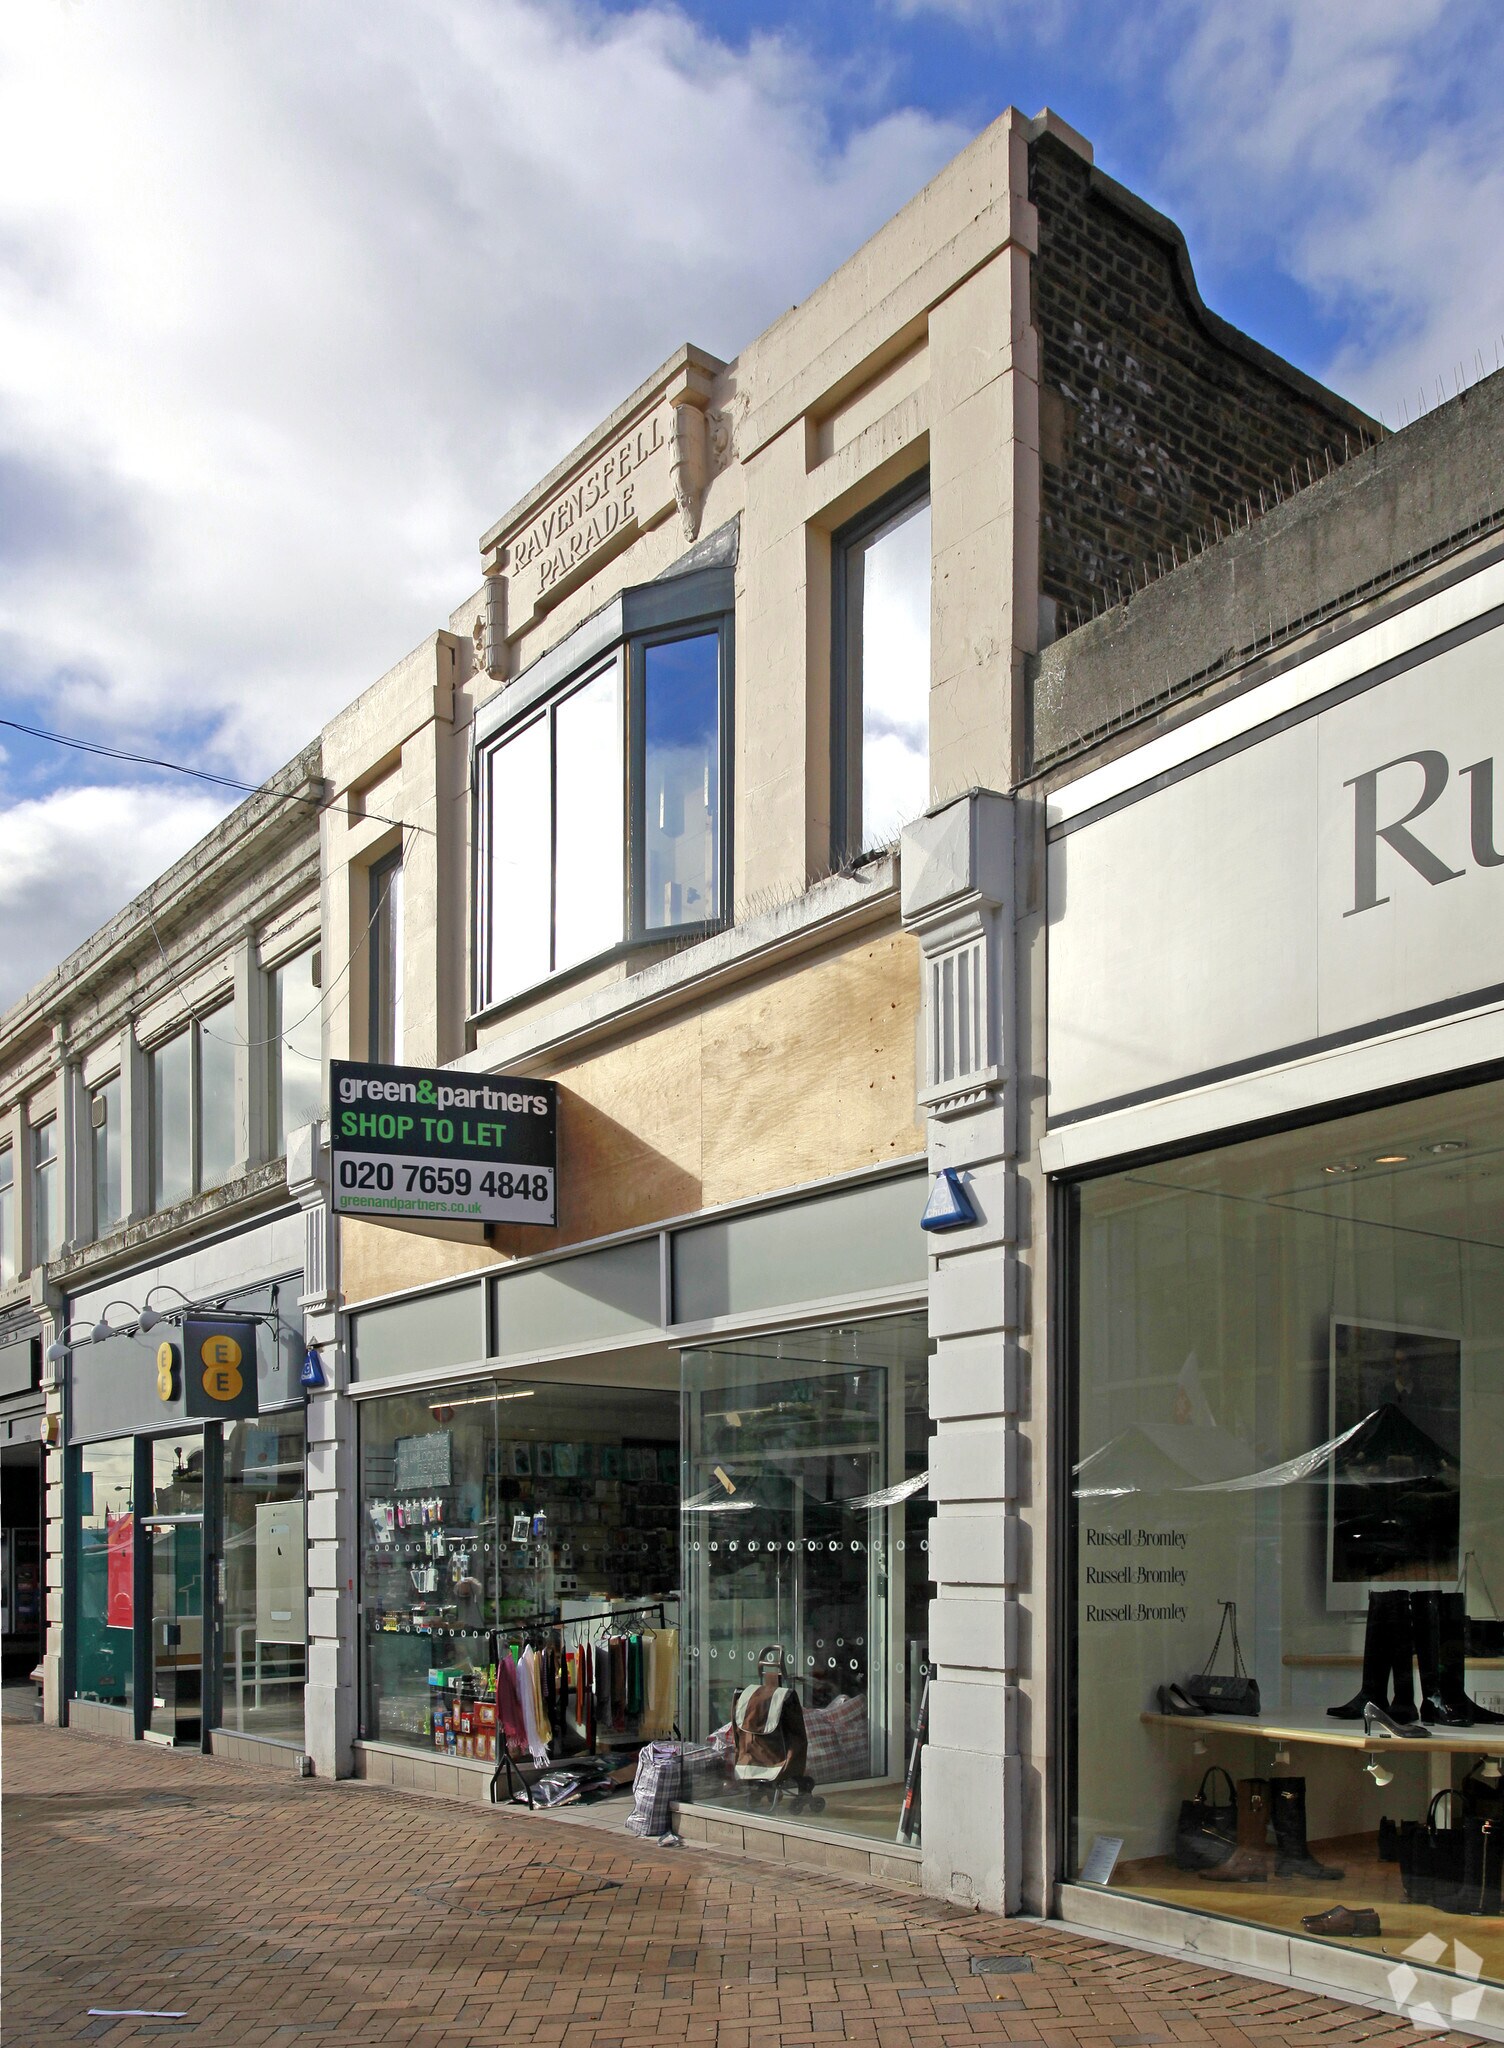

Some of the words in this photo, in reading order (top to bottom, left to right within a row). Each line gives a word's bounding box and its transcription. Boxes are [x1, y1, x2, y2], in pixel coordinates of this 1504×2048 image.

[512, 418, 664, 577] RAVENSFELL
[538, 482, 635, 595] PARADE
[1342, 750, 1504, 918] Ru
[339, 1077, 548, 1114] green&partners
[341, 1111, 414, 1140] SHOP
[420, 1118, 454, 1143] TO
[462, 1121, 507, 1147] LET
[340, 1160, 394, 1191] 020
[402, 1164, 472, 1196] 7659
[479, 1170, 549, 1202] 4848
[340, 1195, 482, 1214] greenandpartners.co.uk
[1086, 1528, 1131, 1546] Russell
[1138, 1529, 1186, 1549] Bromley
[1086, 1566, 1131, 1584] Russell
[1138, 1566, 1186, 1586] Bromley
[1086, 1604, 1131, 1622] Russell
[1138, 1603, 1186, 1622] Bromley
